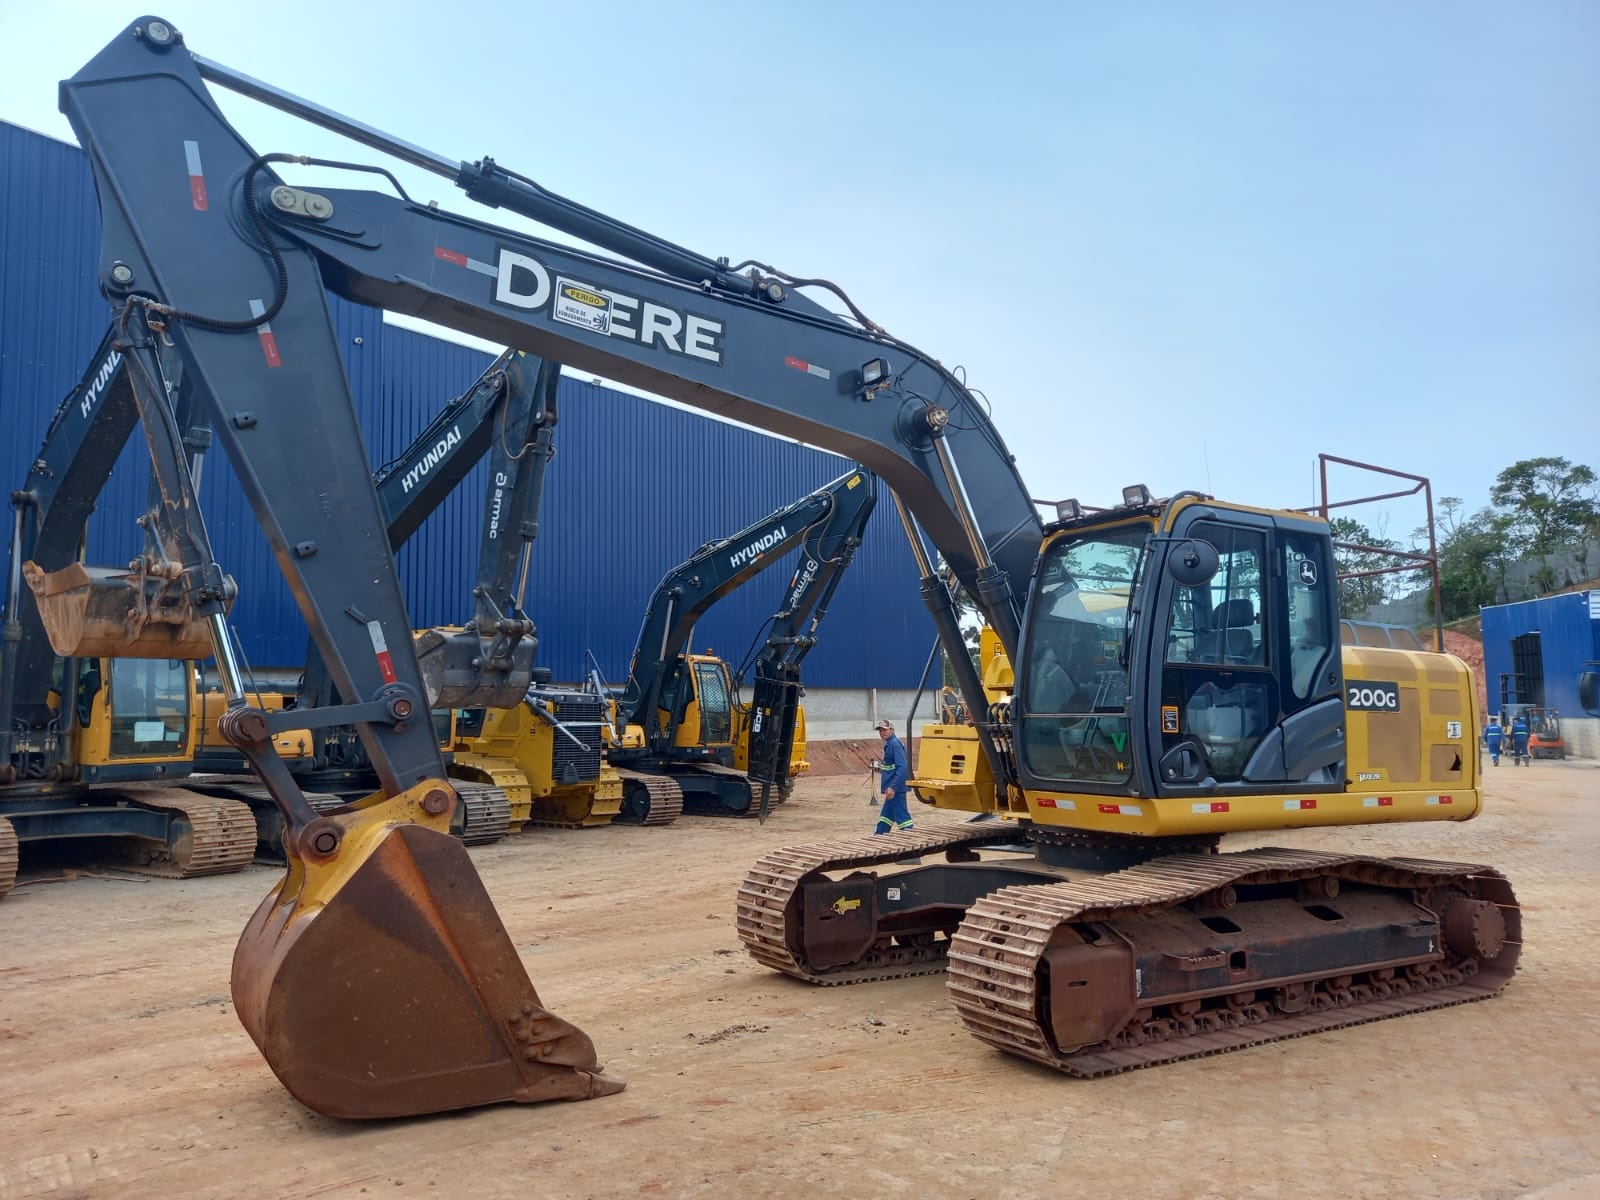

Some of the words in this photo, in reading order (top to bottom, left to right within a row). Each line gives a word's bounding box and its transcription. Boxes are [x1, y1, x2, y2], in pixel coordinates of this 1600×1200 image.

[570, 290, 600, 305] PERIGO
[81, 349, 121, 419] HYUND
[401, 425, 462, 494] HYUNDAI
[489, 488, 503, 540] armac
[729, 525, 787, 568] HYUNDAI
[754, 706, 763, 733] JCB
[1349, 688, 1396, 708] 200G
